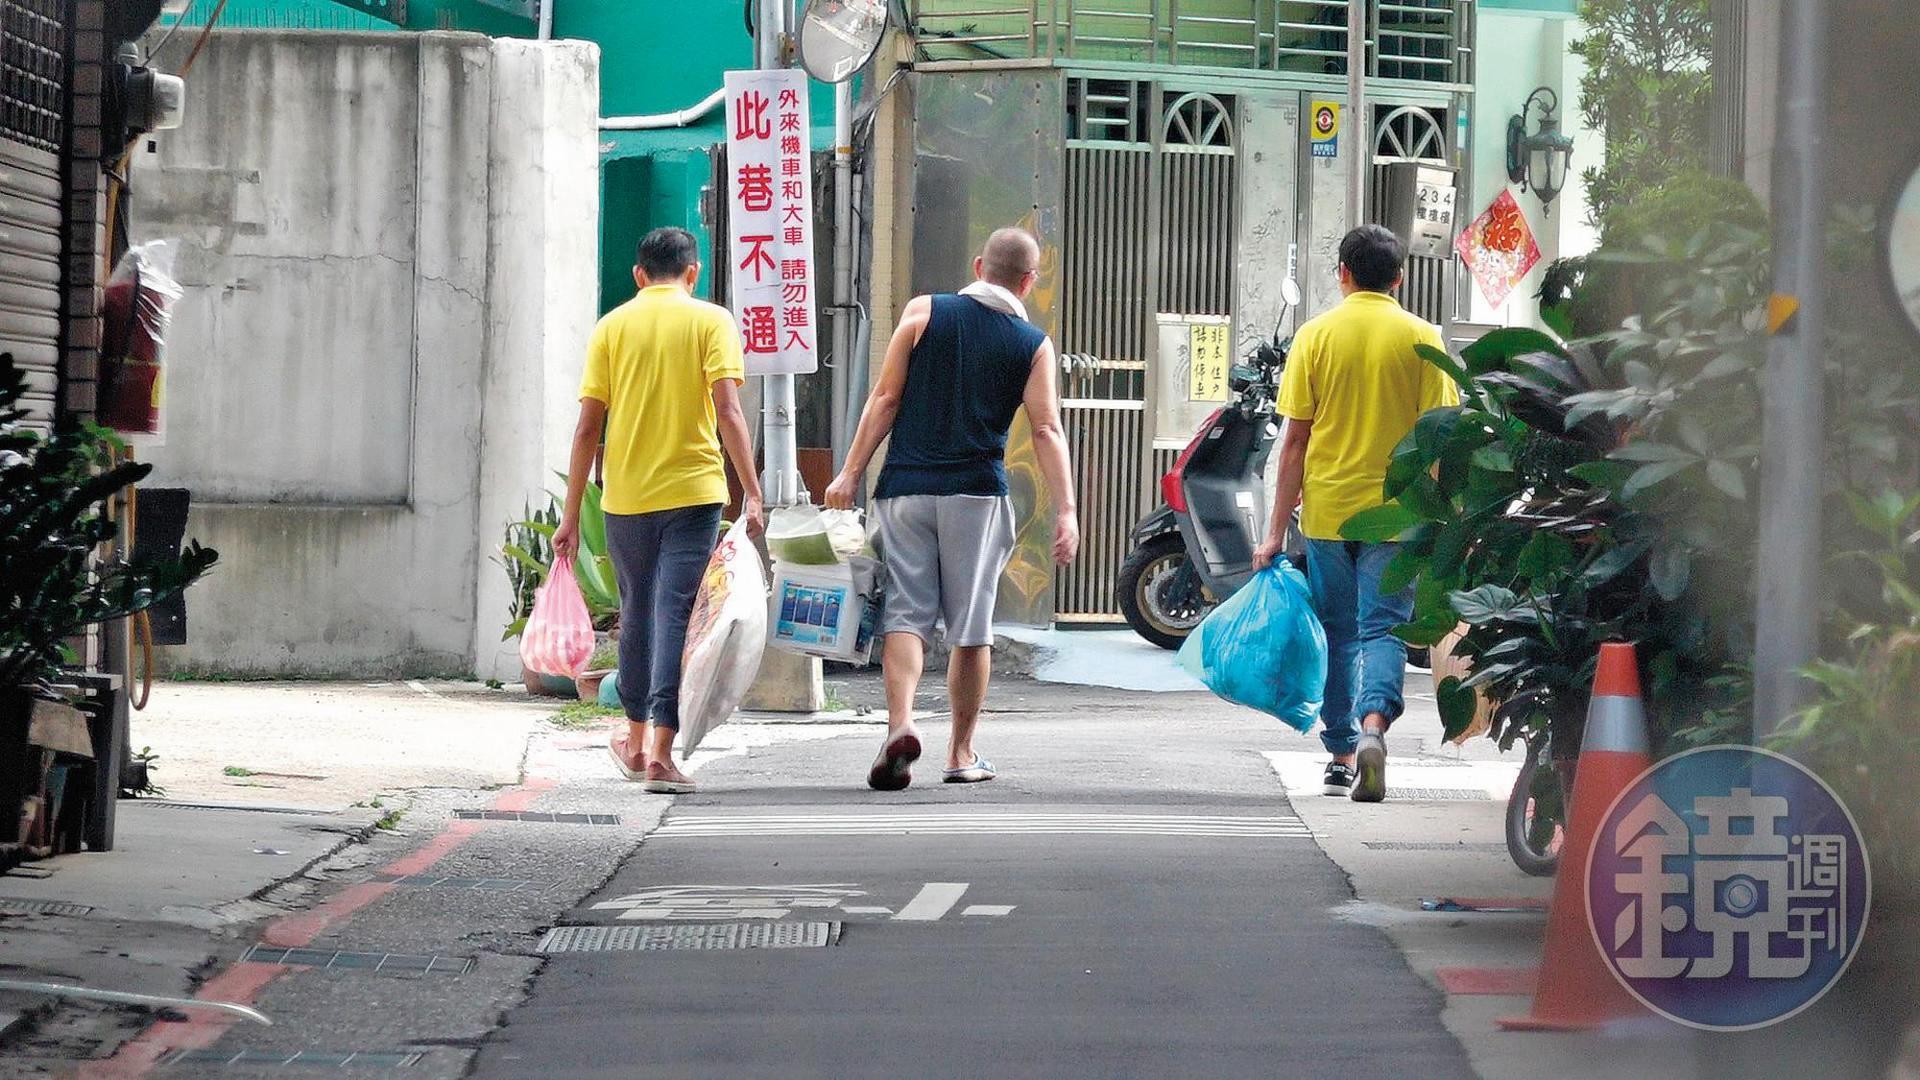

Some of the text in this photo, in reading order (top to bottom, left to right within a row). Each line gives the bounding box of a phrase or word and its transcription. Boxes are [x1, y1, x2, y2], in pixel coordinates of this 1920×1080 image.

[735, 89, 779, 355] 此巷不通
[1484, 206, 1522, 252] 福
[1193, 325, 1207, 399] 請勿停車
